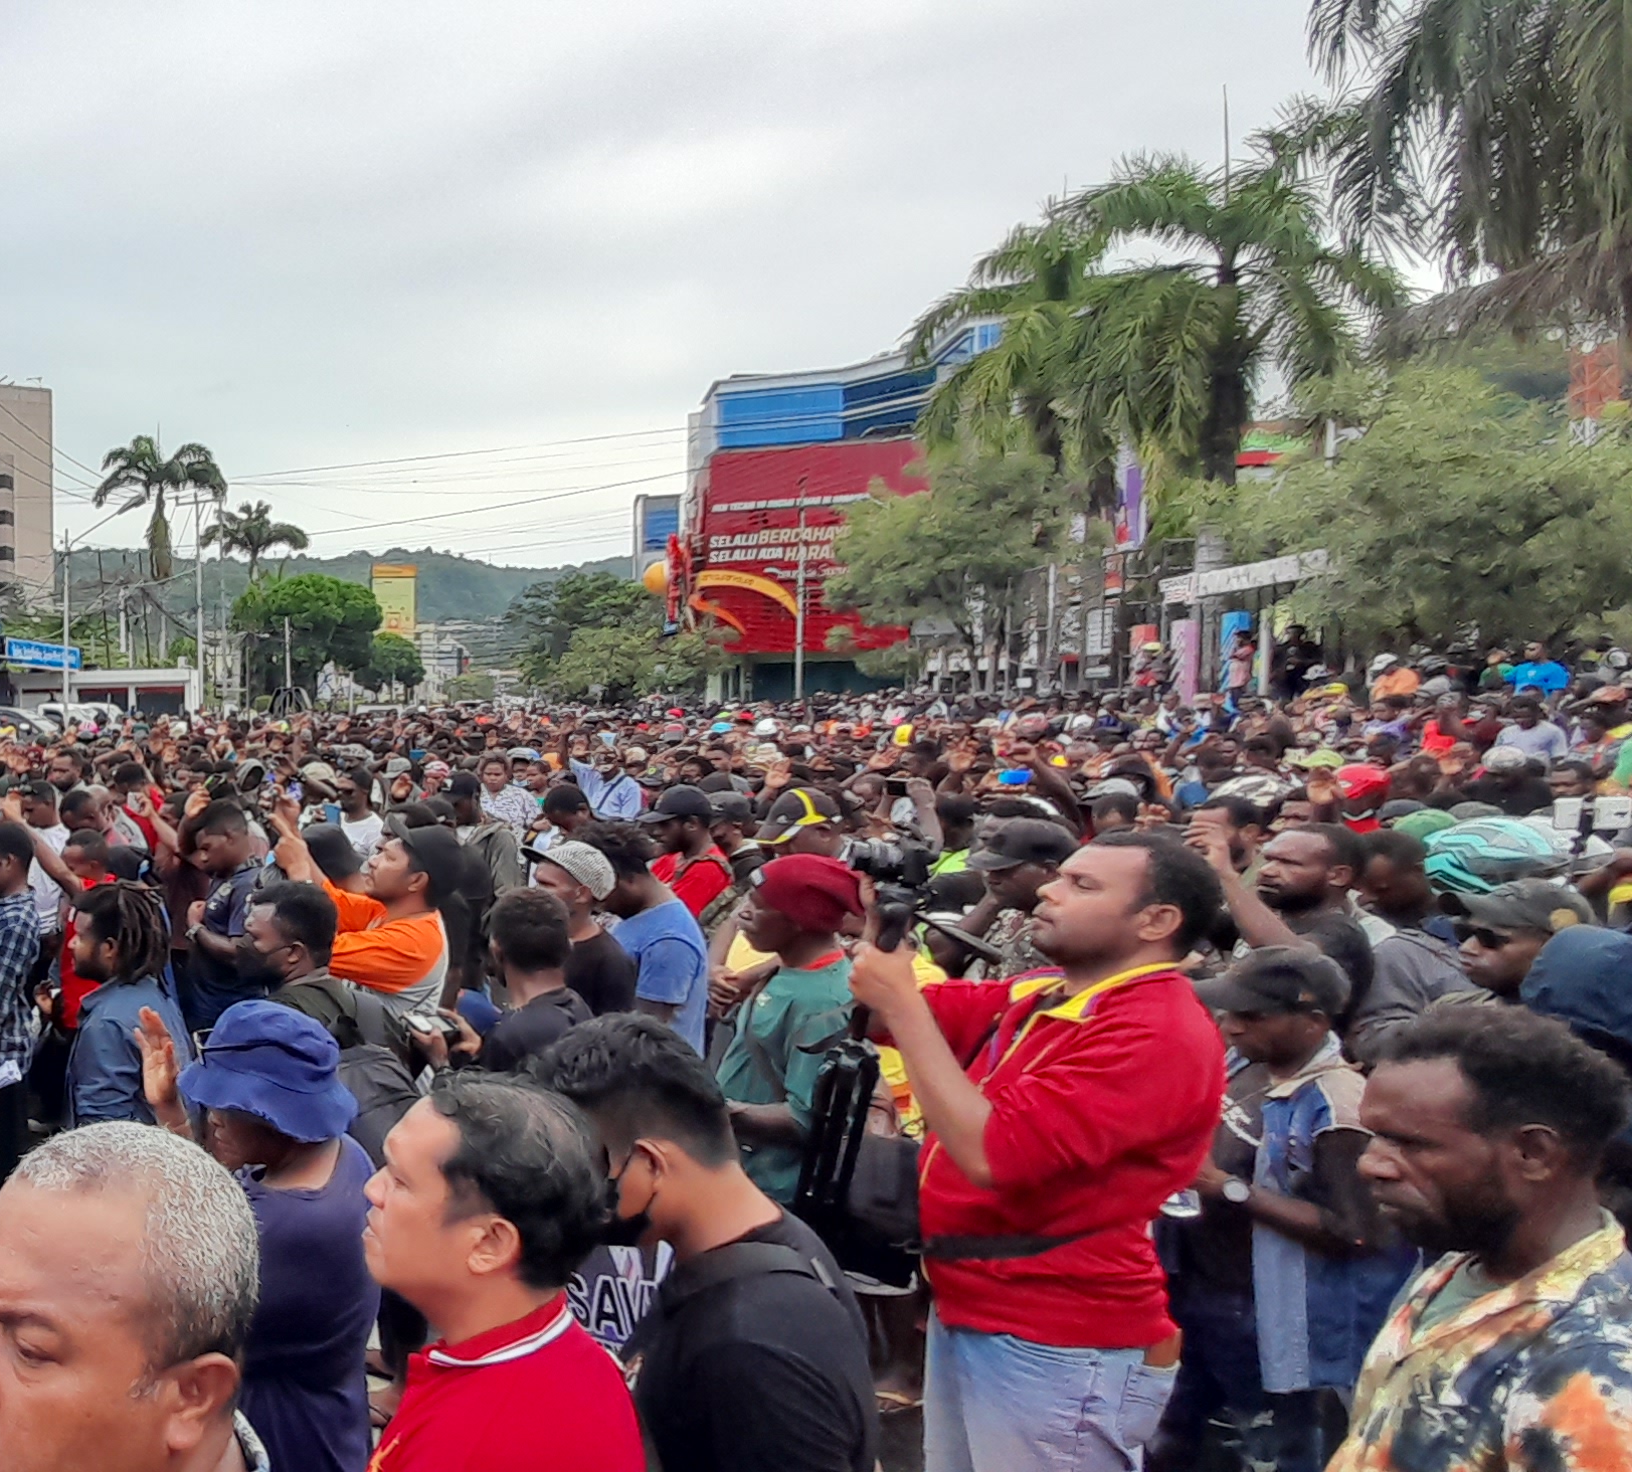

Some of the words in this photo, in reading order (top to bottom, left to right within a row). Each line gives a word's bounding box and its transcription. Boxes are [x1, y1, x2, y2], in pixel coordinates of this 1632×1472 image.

[709, 533, 758, 548] SELALU
[708, 548, 758, 563] SELALU
[758, 546, 784, 559] ADA
